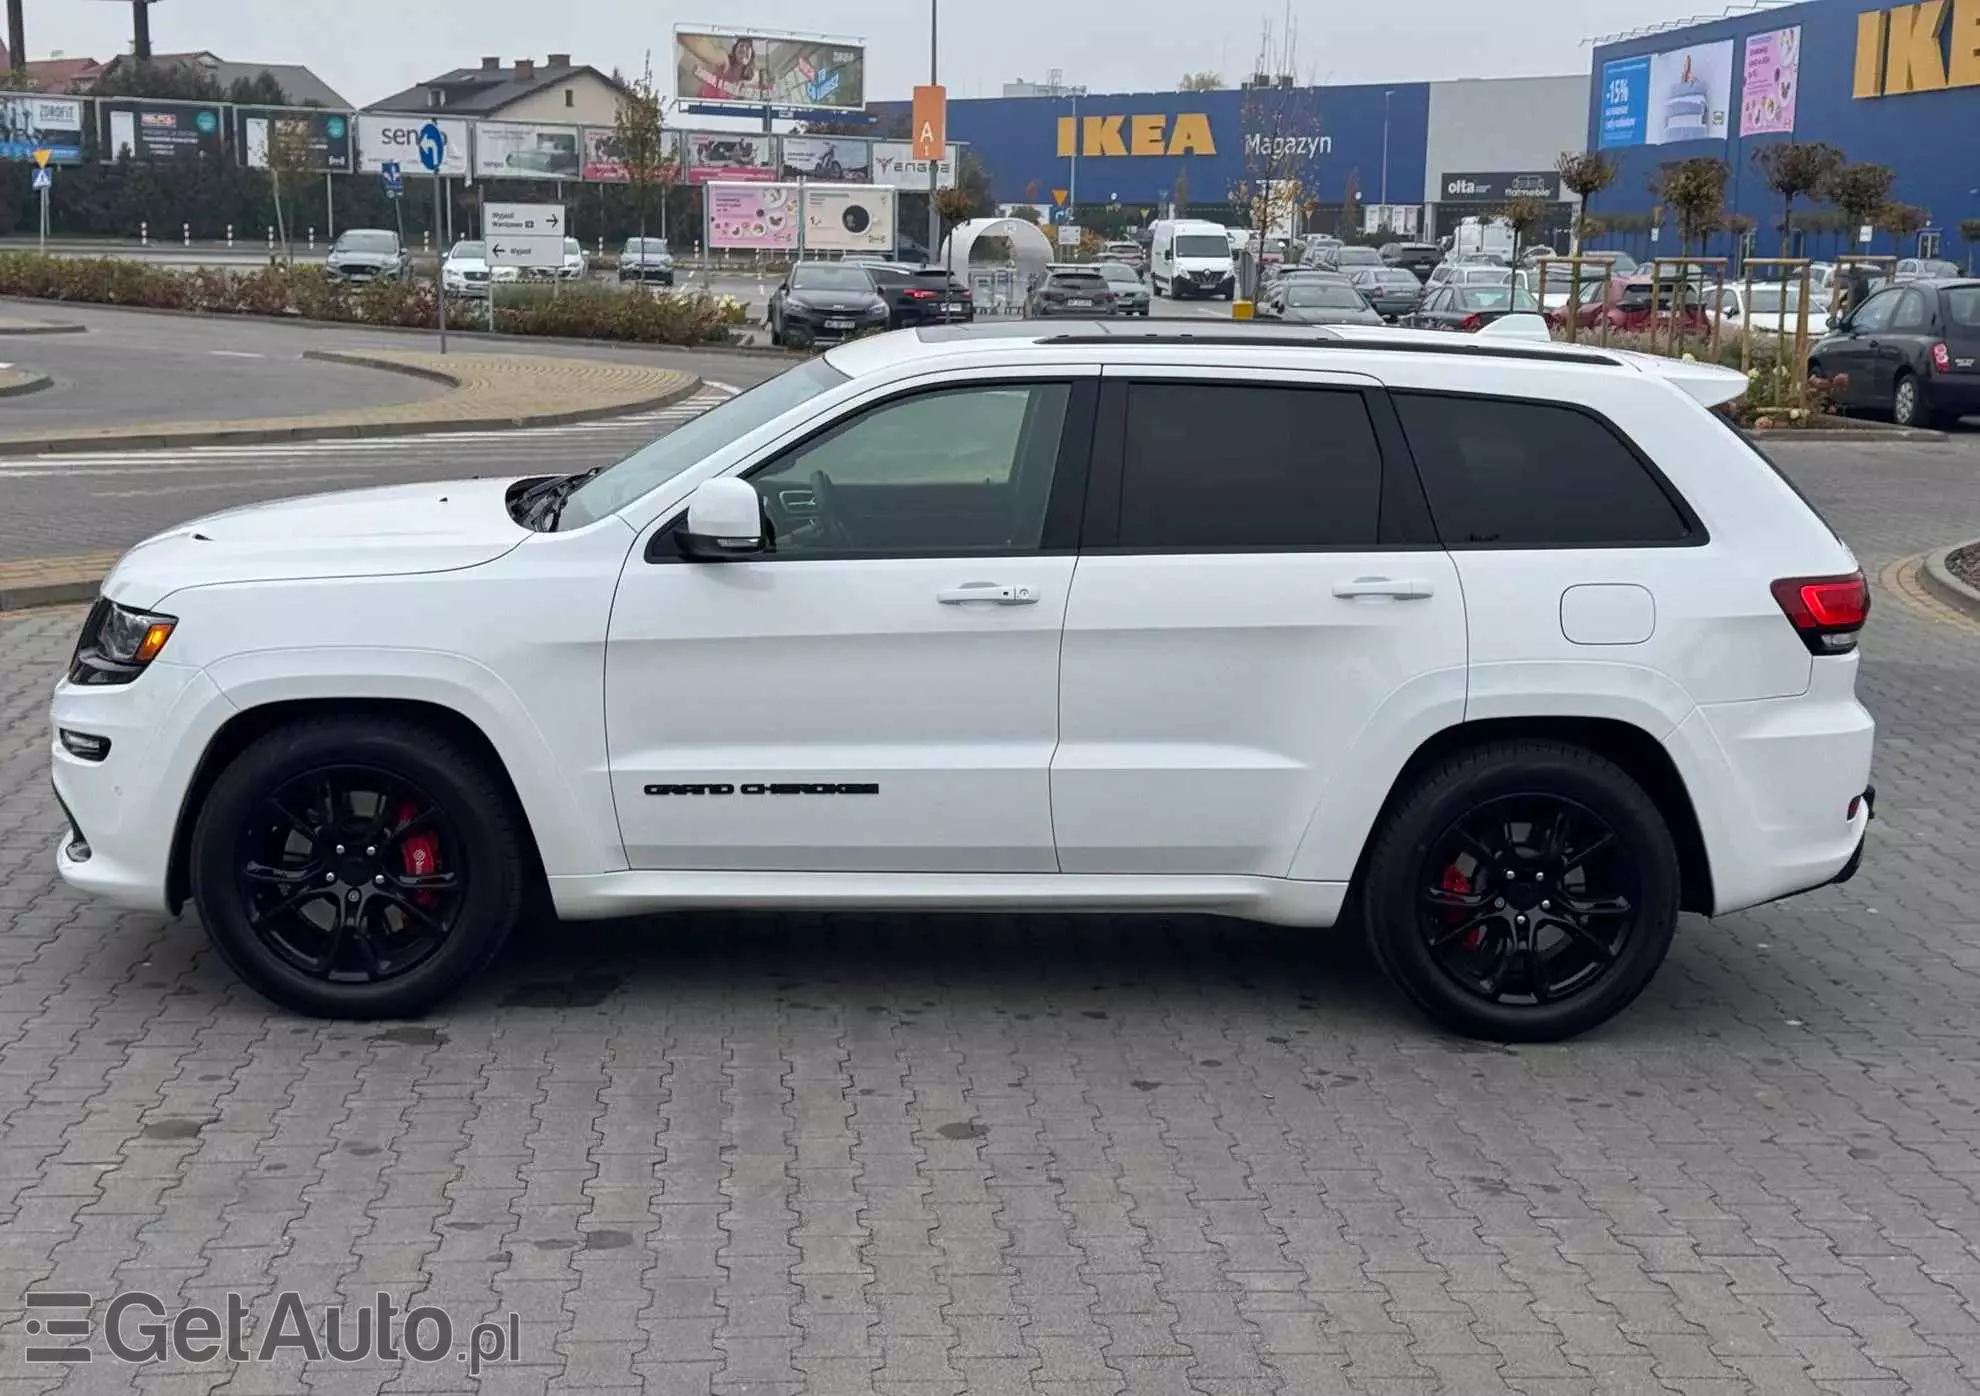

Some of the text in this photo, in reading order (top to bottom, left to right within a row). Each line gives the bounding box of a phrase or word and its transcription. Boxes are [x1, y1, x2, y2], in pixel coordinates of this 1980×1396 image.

[920, 120, 935, 143] A
[1056, 112, 1217, 157] IKEA
[1245, 133, 1332, 159] Magazyn
[1448, 179, 1476, 194] olta
[644, 783, 879, 795] GRAND CHEROKEE
